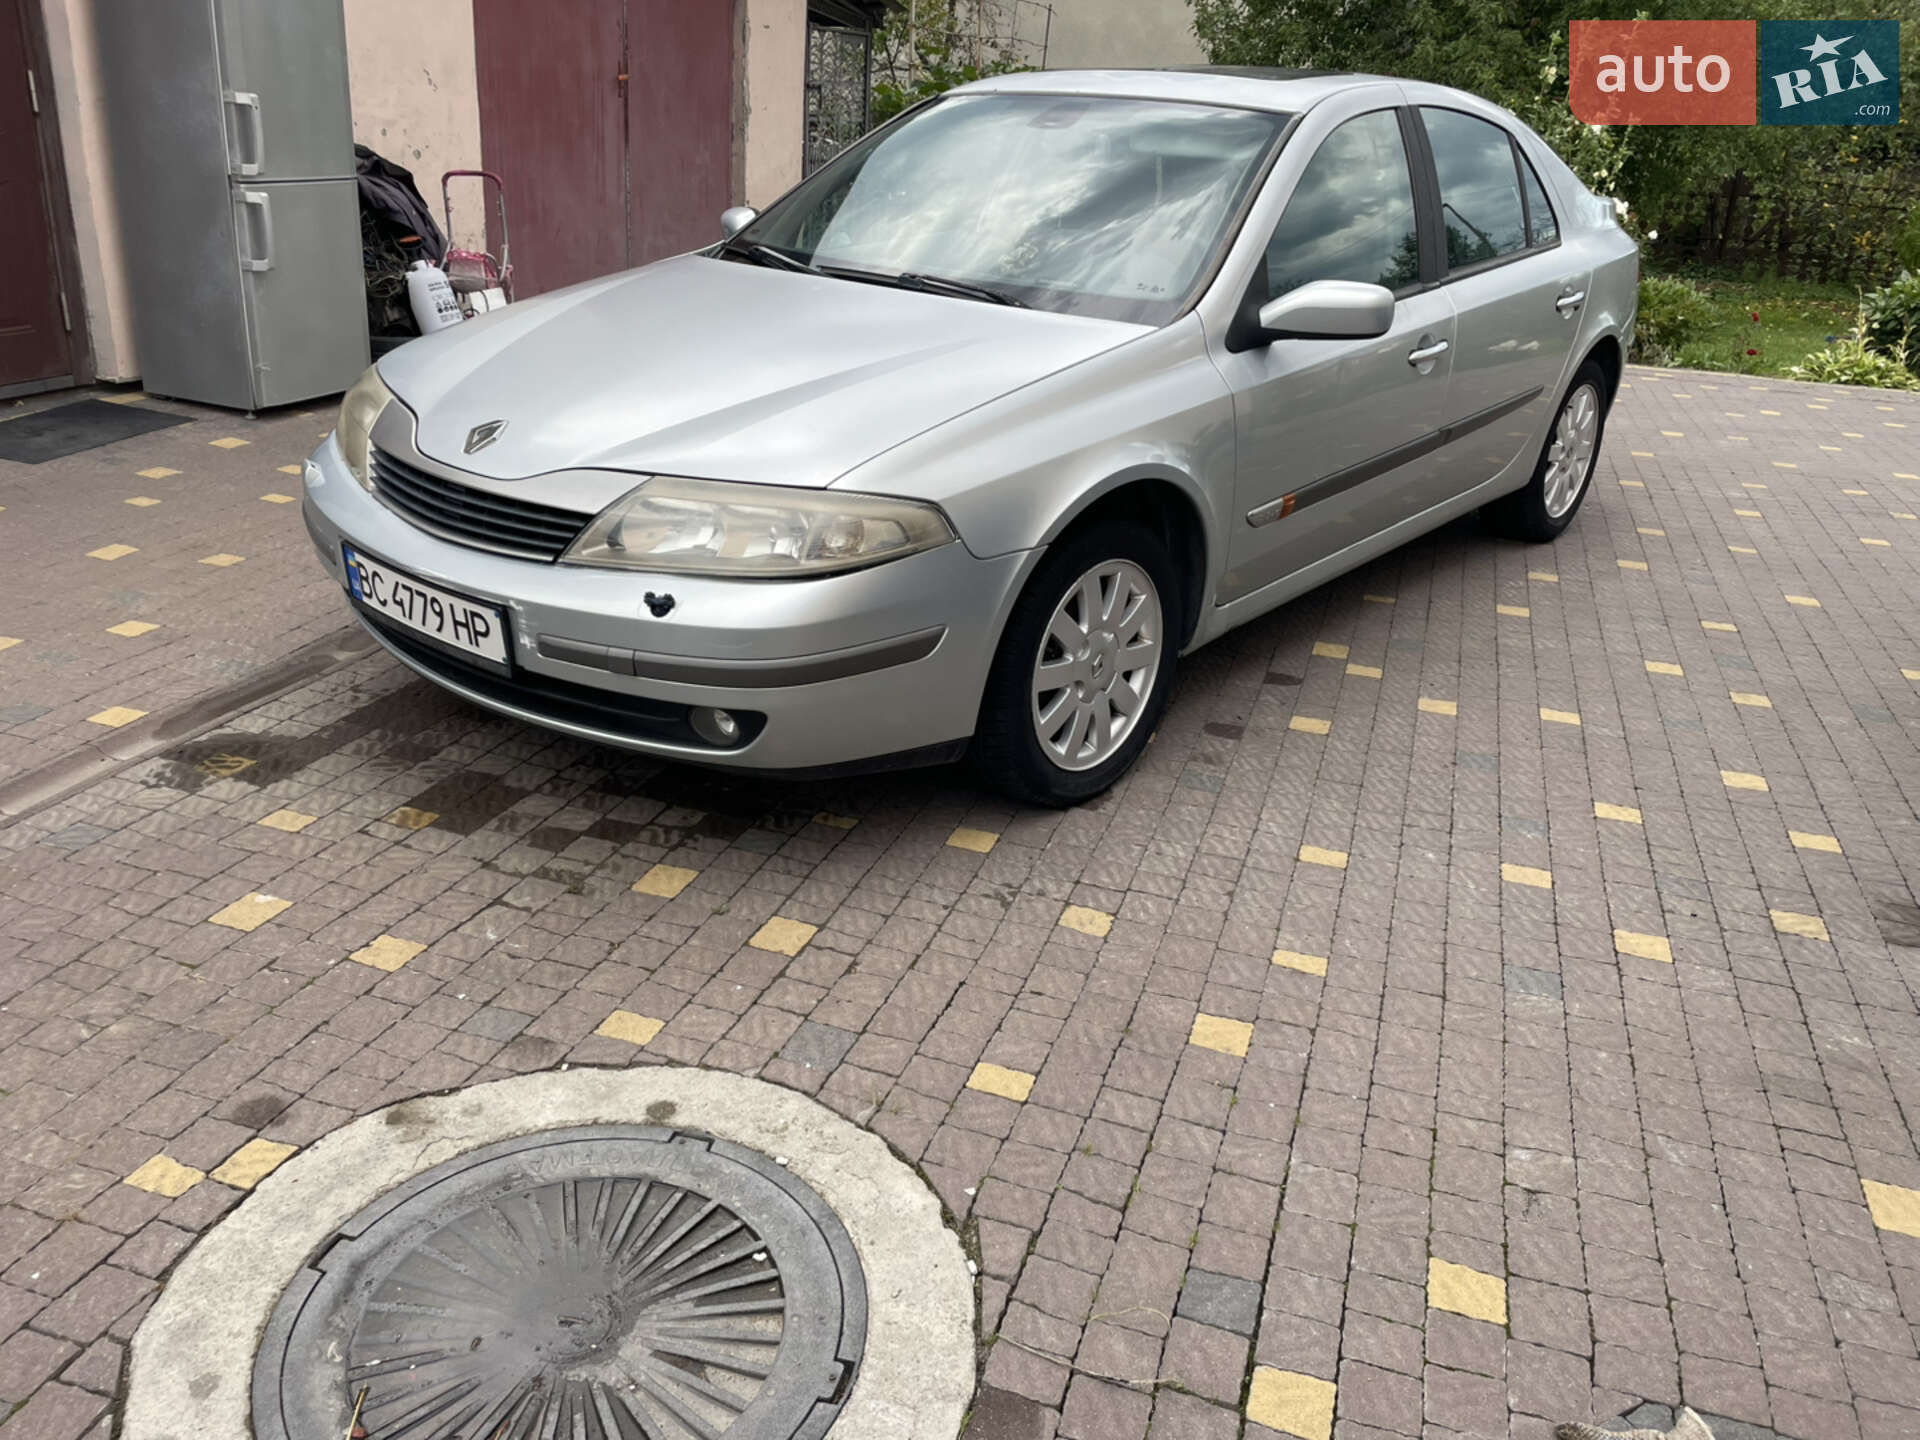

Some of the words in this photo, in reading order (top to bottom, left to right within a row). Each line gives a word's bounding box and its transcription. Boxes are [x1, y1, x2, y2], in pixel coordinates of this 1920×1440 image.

[356, 560, 388, 607] BC
[392, 581, 444, 633] 4779
[449, 603, 490, 648] HP
